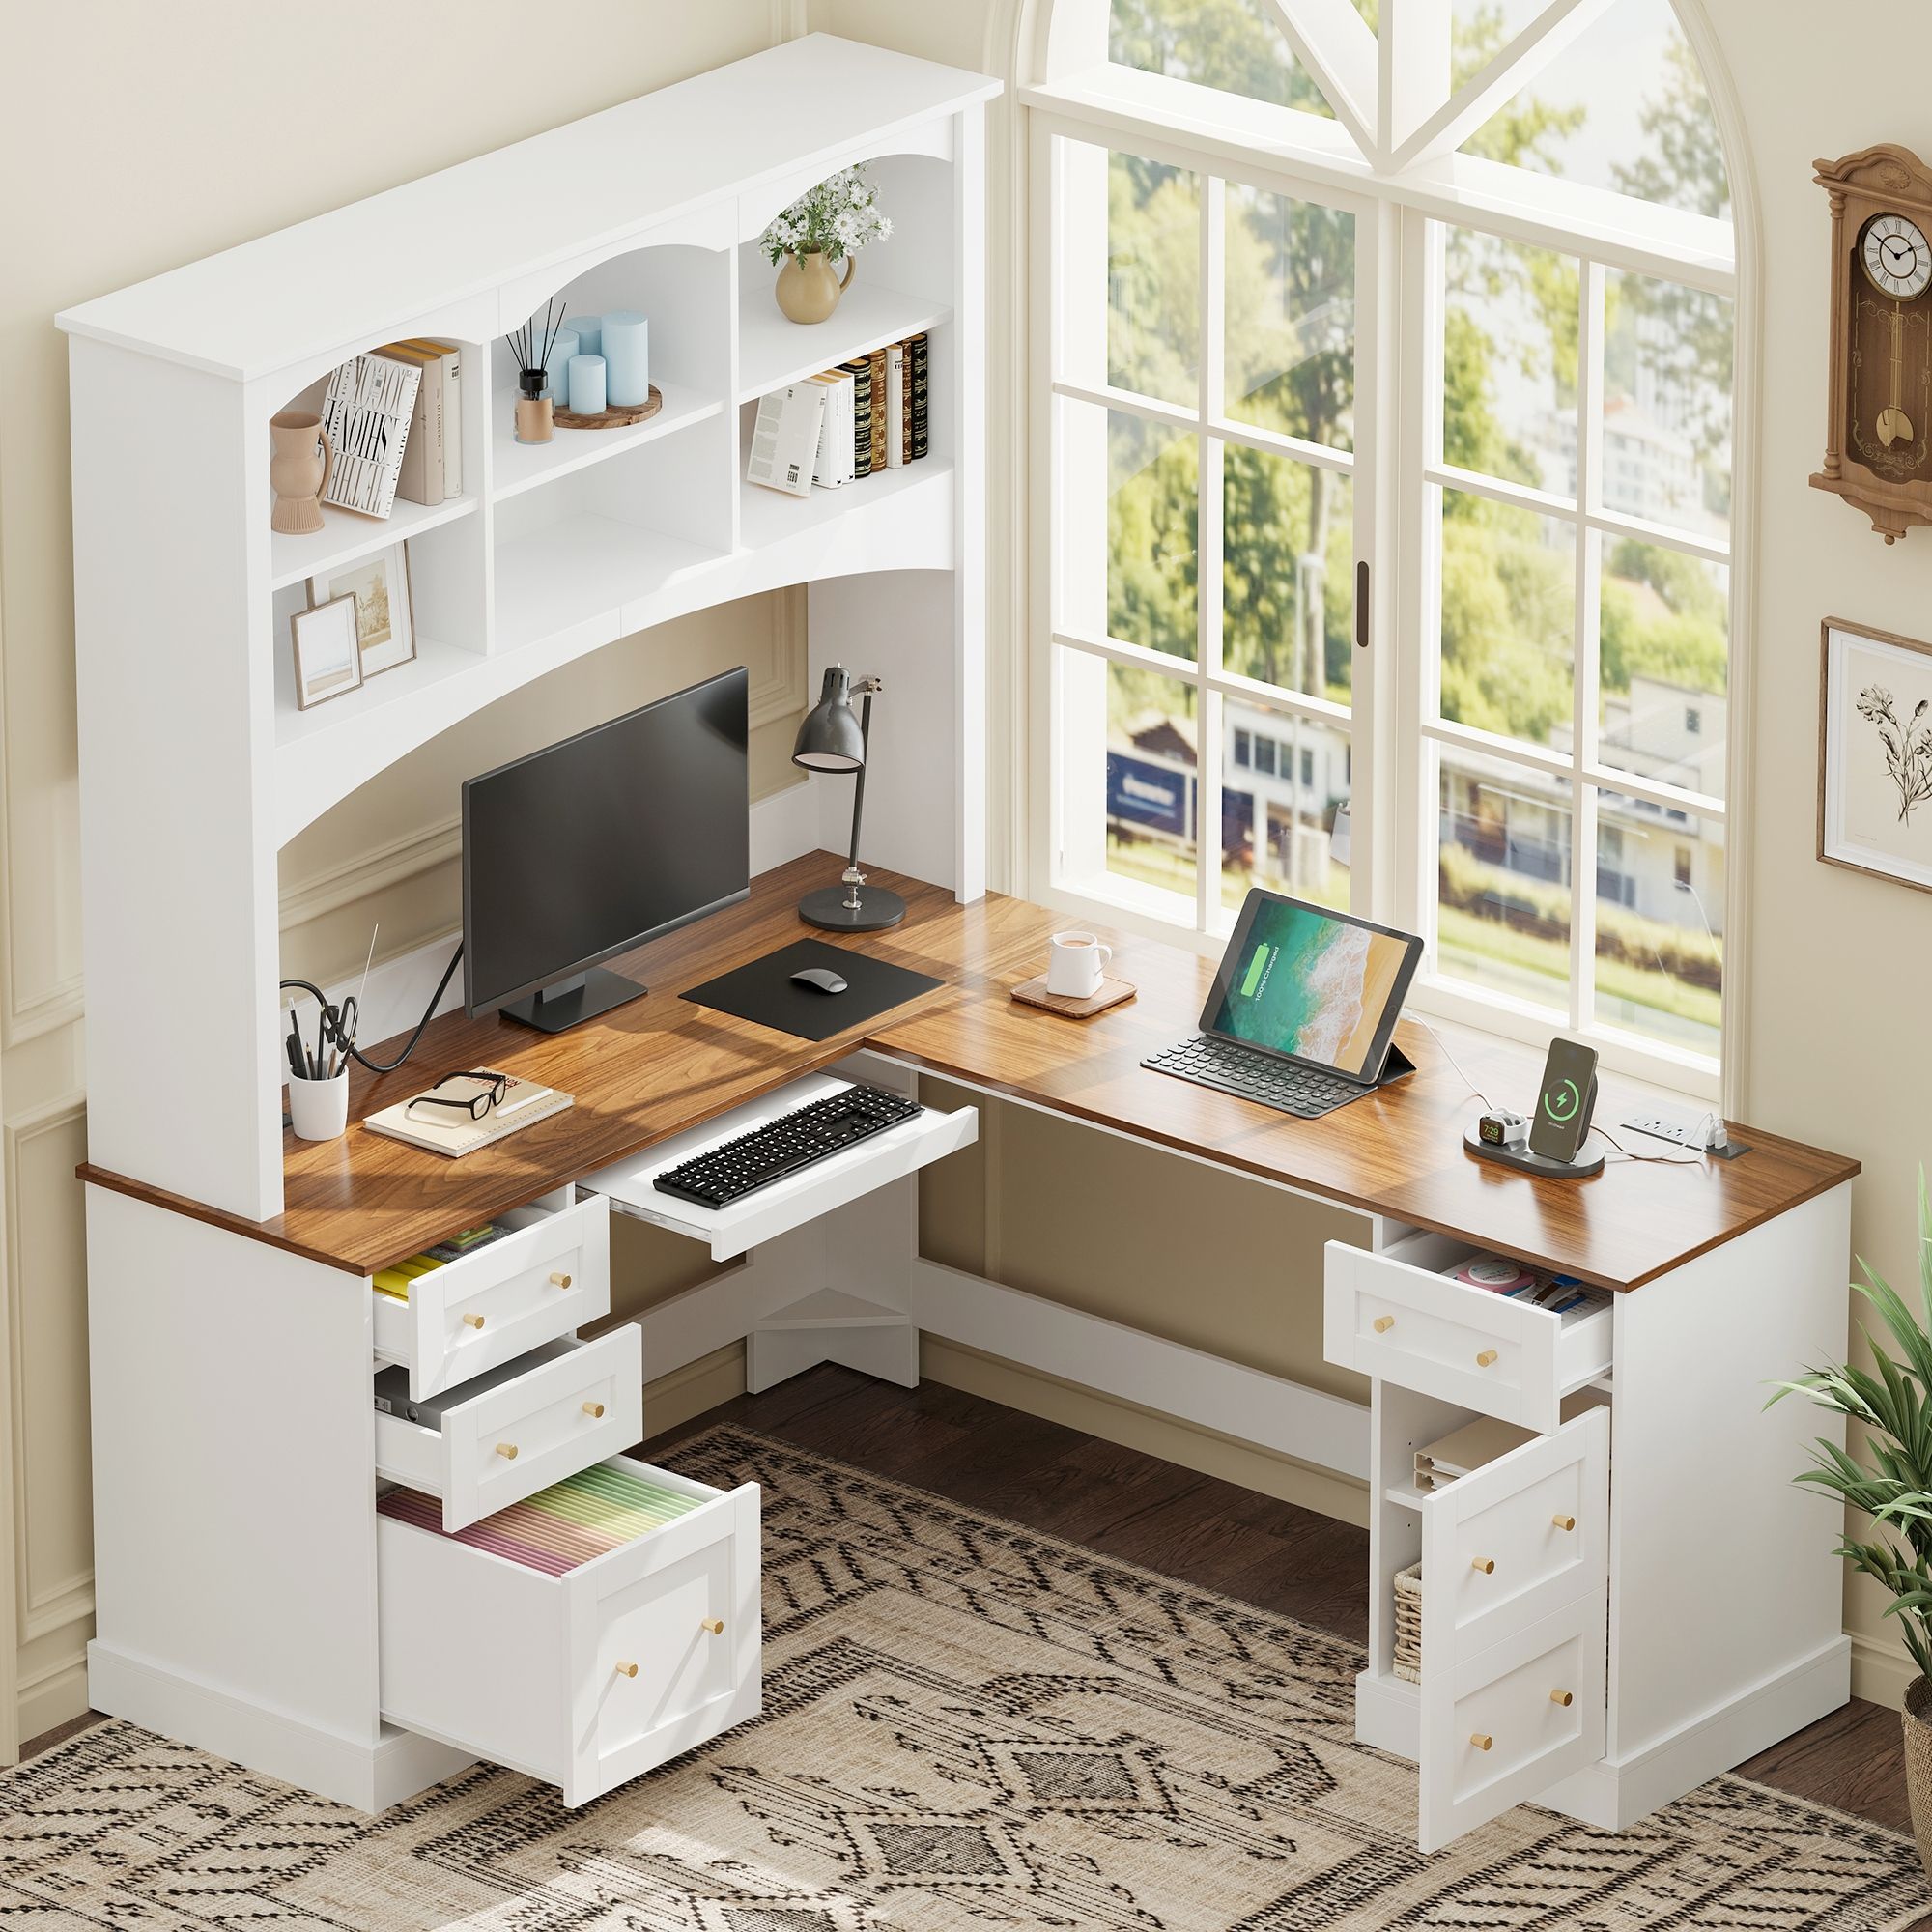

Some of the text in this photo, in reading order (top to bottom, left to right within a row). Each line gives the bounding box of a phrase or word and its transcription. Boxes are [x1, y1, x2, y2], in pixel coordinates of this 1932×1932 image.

[1255, 946, 1280, 1001] 100% Charged
[1484, 1124, 1499, 1137] 7:29
